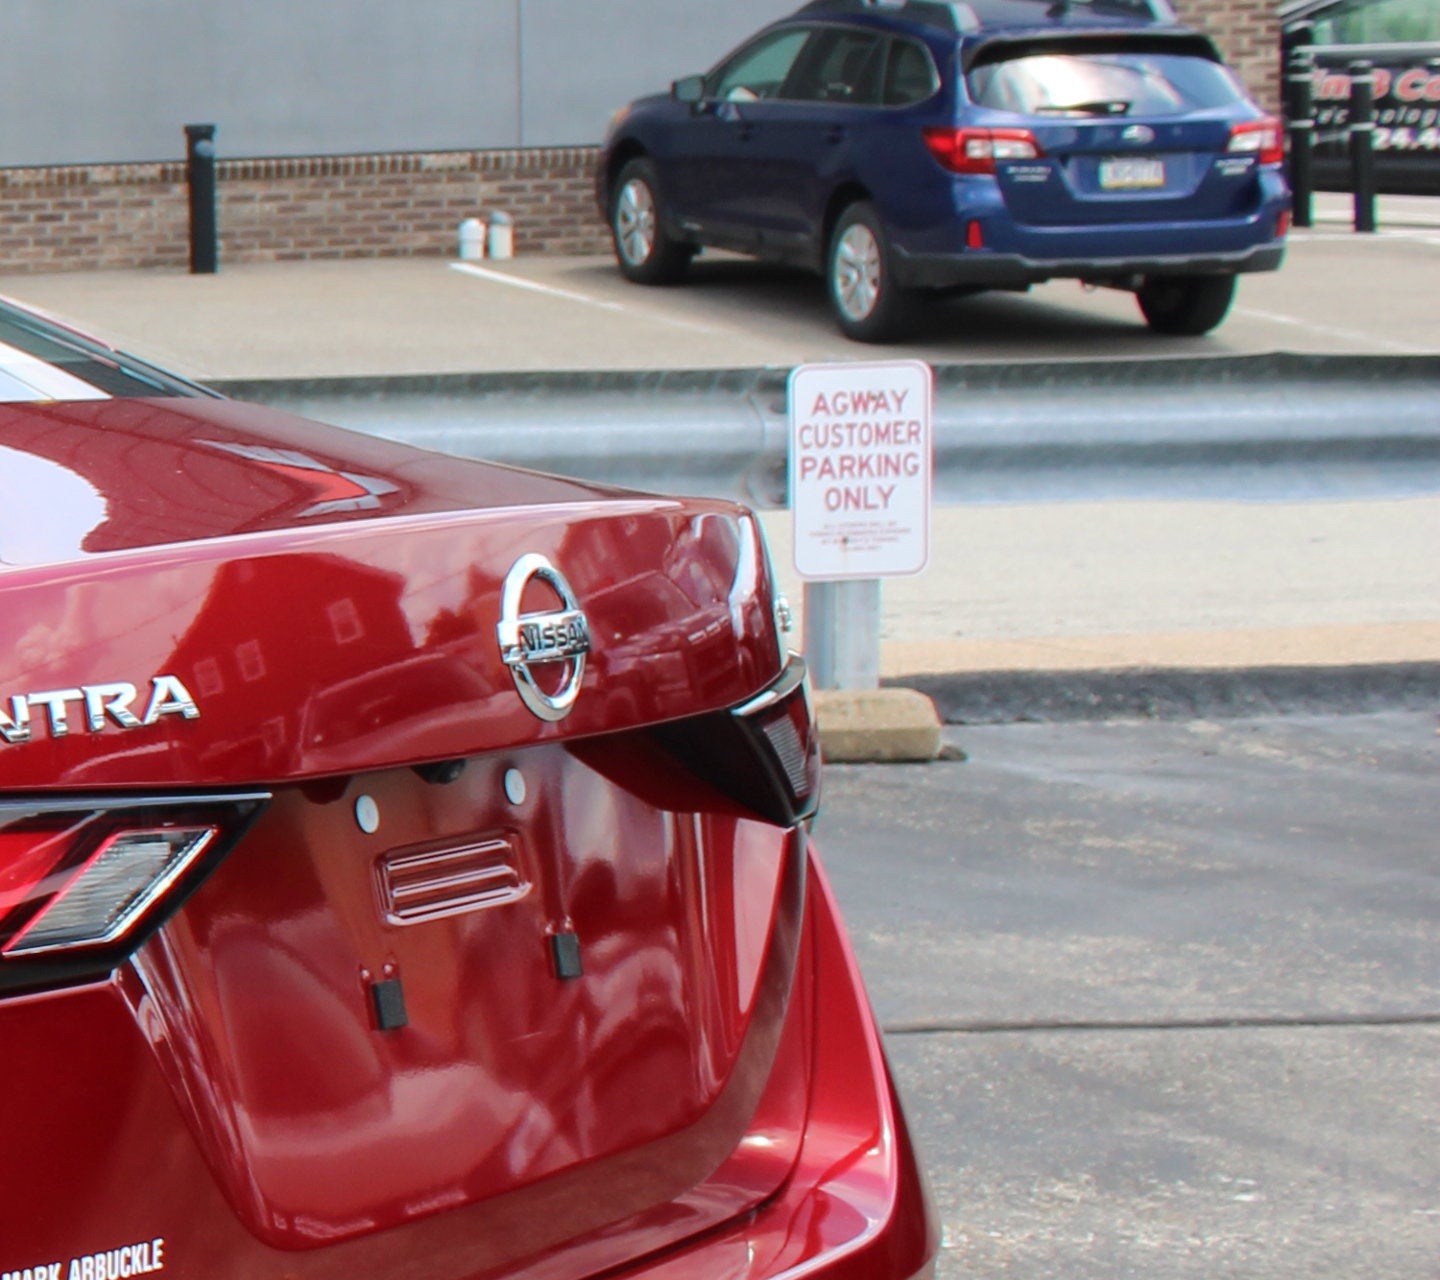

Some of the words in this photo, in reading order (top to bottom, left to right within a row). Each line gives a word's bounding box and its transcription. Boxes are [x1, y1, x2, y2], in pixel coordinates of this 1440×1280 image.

[812, 390, 909, 417] AGWAY
[798, 421, 921, 449] CUSTOMER
[799, 452, 920, 481] PARKING
[824, 485, 895, 512] ONLY
[521, 617, 589, 652] NISSAN
